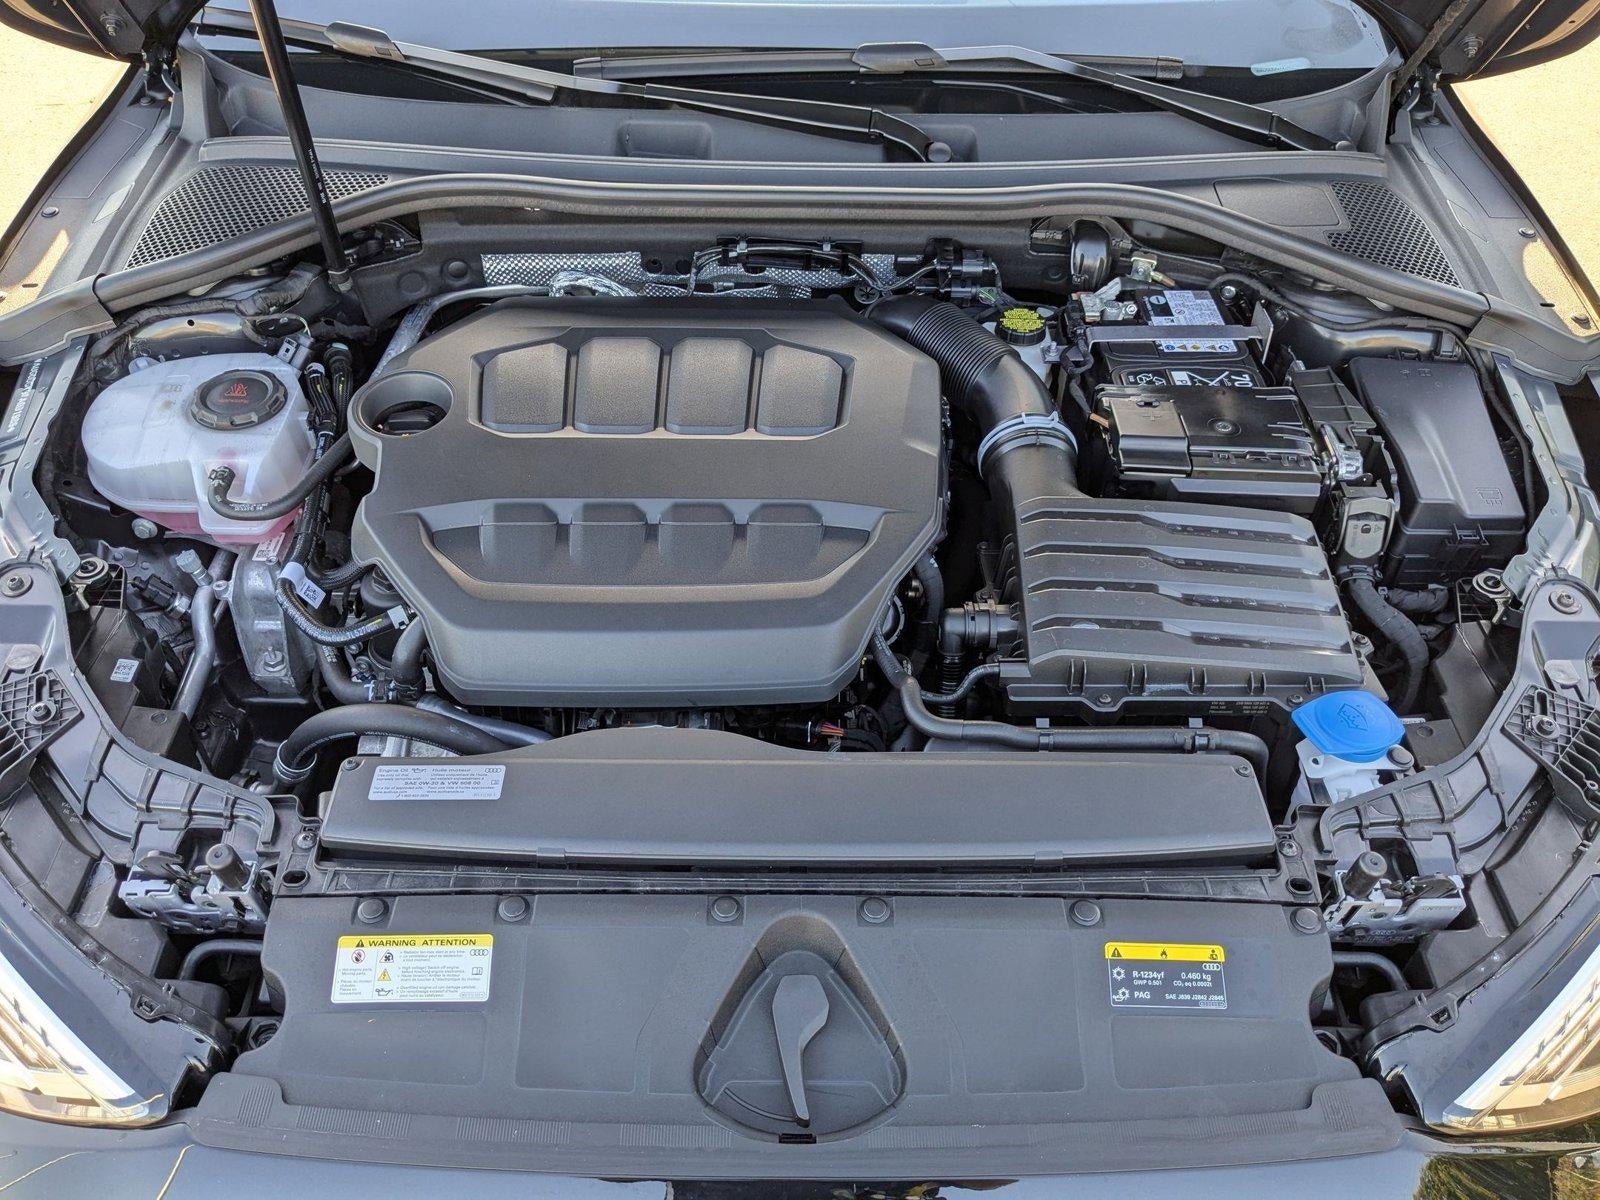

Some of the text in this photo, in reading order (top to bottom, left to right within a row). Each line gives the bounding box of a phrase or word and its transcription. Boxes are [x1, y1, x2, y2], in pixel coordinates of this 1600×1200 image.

[368, 938, 477, 947] WARNING ATTENTION
[1132, 970, 1212, 982] R-1234yf 0.460 kg
[1134, 991, 1151, 999] PAG
